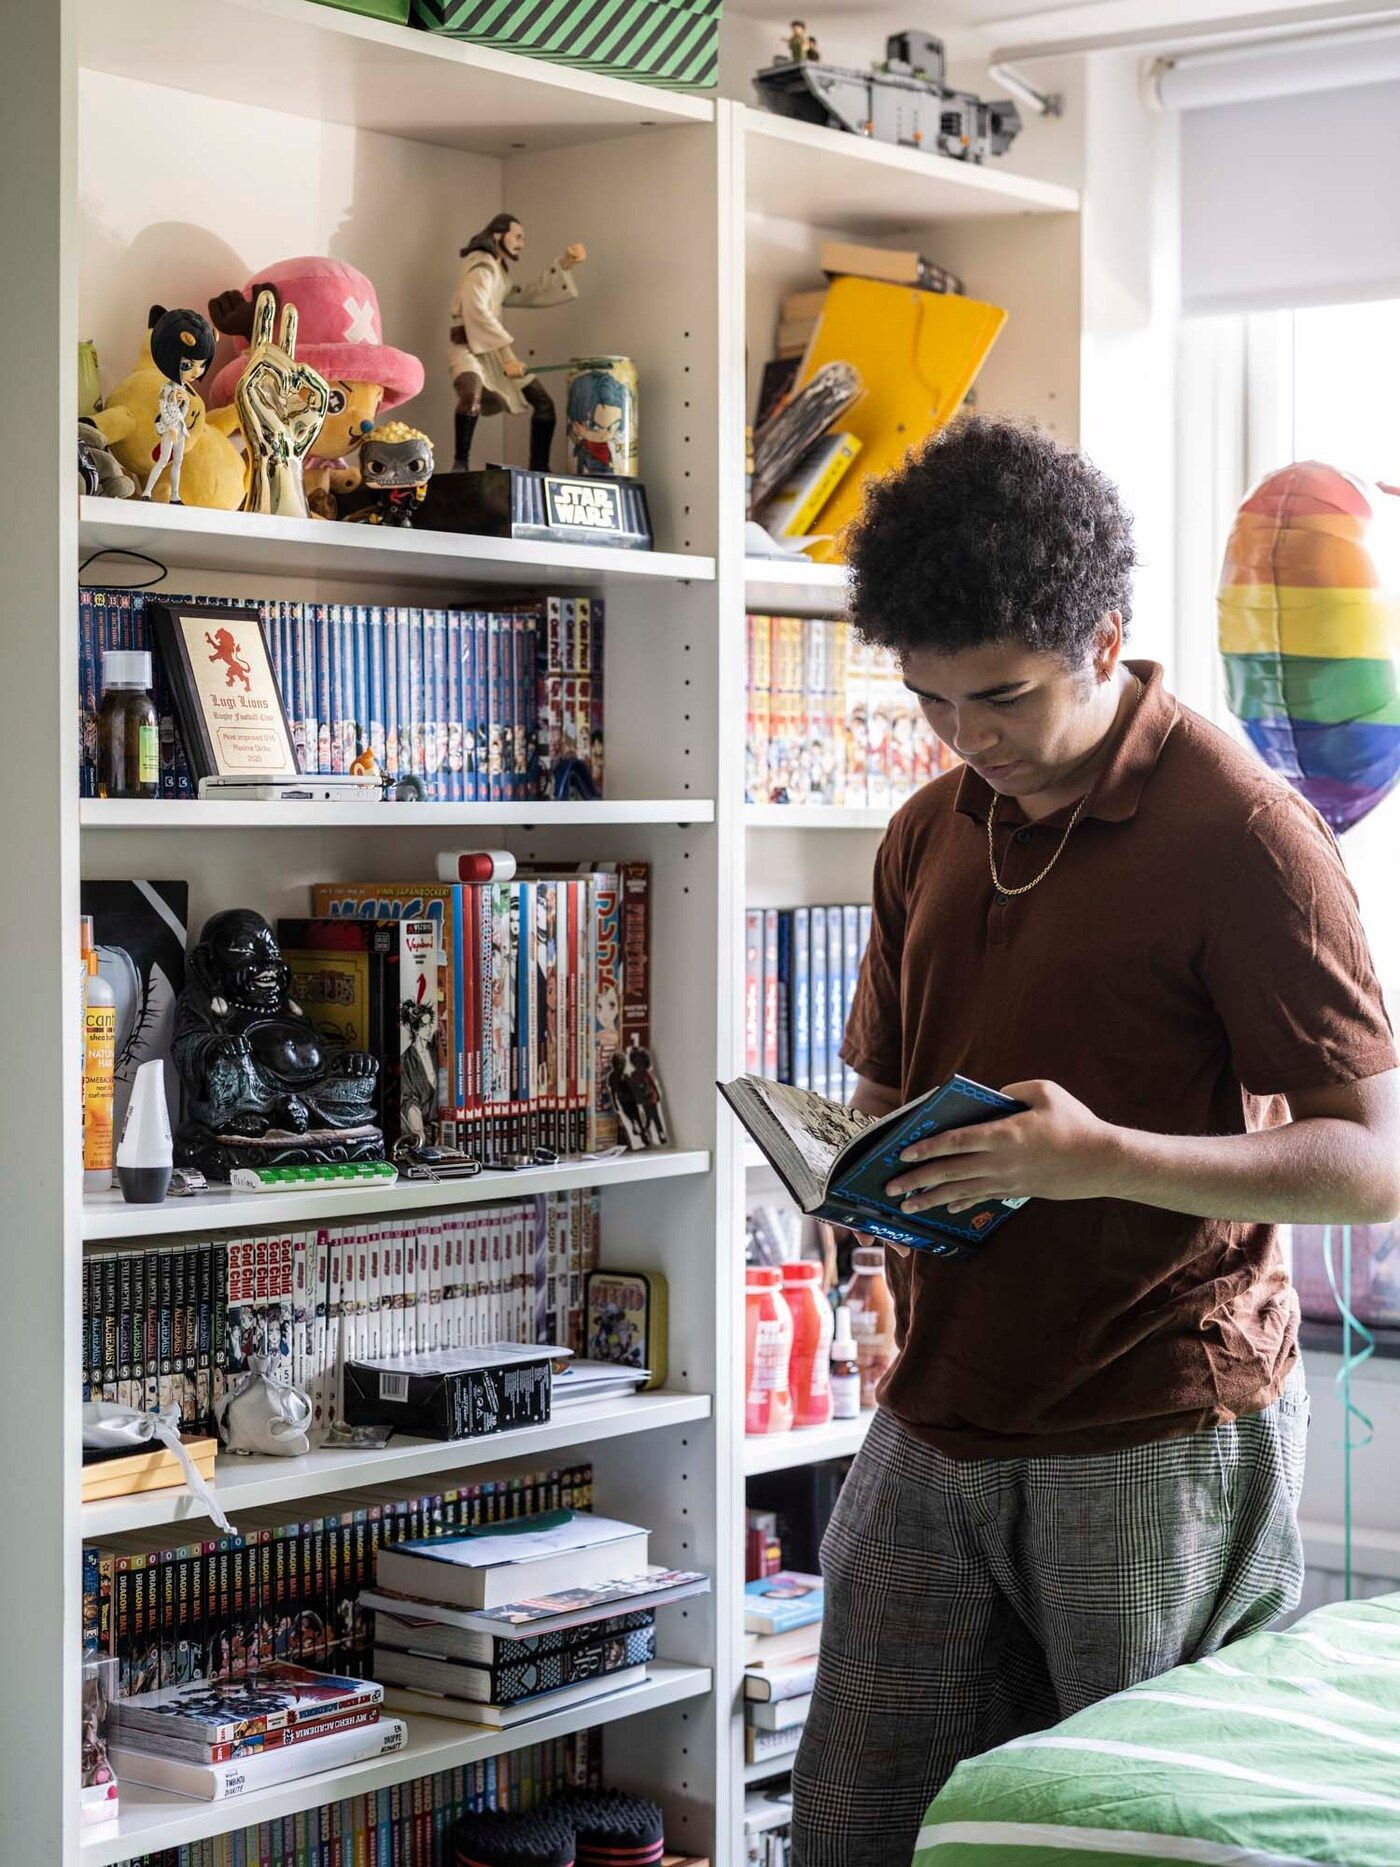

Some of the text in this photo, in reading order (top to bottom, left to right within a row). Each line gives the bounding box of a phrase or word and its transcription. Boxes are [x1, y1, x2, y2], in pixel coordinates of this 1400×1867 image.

[554, 484, 613, 508] STAR
[555, 503, 615, 527] WARS
[95, 594, 105, 605] 12
[109, 596, 117, 605] 13
[209, 694, 269, 710] Lugi Lions
[89, 1033, 105, 1041] shea
[631, 1033, 640, 1048] 1
[230, 1246, 241, 1301] God Child
[242, 1243, 253, 1299] God Child
[257, 1242, 267, 1298] God Child
[269, 1241, 280, 1297] God Child
[281, 1240, 291, 1295] God Child
[133, 1312, 143, 1362] ALCHEMIST
[147, 1307, 157, 1358] ALCHEMIST
[161, 1308, 171, 1358] ALCHEMIST
[174, 1307, 184, 1356] ALCHEMIST
[186, 1305, 196, 1354] ALCHEMIST
[200, 1303, 210, 1352] ALCHEMIST
[215, 1301, 225, 1349] ALCHEMIST
[92, 1317, 101, 1368] ALCHEMIST
[105, 1315, 115, 1366] ALCHEMIST
[120, 1313, 130, 1363] ALCHEMIST
[150, 1361, 156, 1372] 7
[163, 1361, 169, 1373] 8
[176, 1360, 181, 1371] 9
[186, 1357, 195, 1369] 10
[201, 1354, 208, 1366] 11
[216, 1352, 224, 1363] 12
[94, 1371, 100, 1382] 3
[107, 1369, 114, 1381] 4
[122, 1364, 128, 1376] 5
[135, 1365, 141, 1376] 6
[329, 1532, 337, 1567] DRAGON
[343, 1528, 351, 1564] DRAGON
[179, 1563, 187, 1600] DRAGON
[262, 1546, 270, 1605] DRAGON BALL
[276, 1543, 284, 1601] DRAGON BALL
[208, 1557, 216, 1616] DRAGON BALL
[119, 1575, 127, 1637] DRAGON BALL
[193, 1600, 201, 1621] BALL
[338, 1697, 358, 1710] HERO
[358, 1694, 371, 1705] MY
[296, 1720, 334, 1739] ACADEMIA
[335, 1717, 356, 1729] HERO
[355, 1713, 367, 1724] MY
